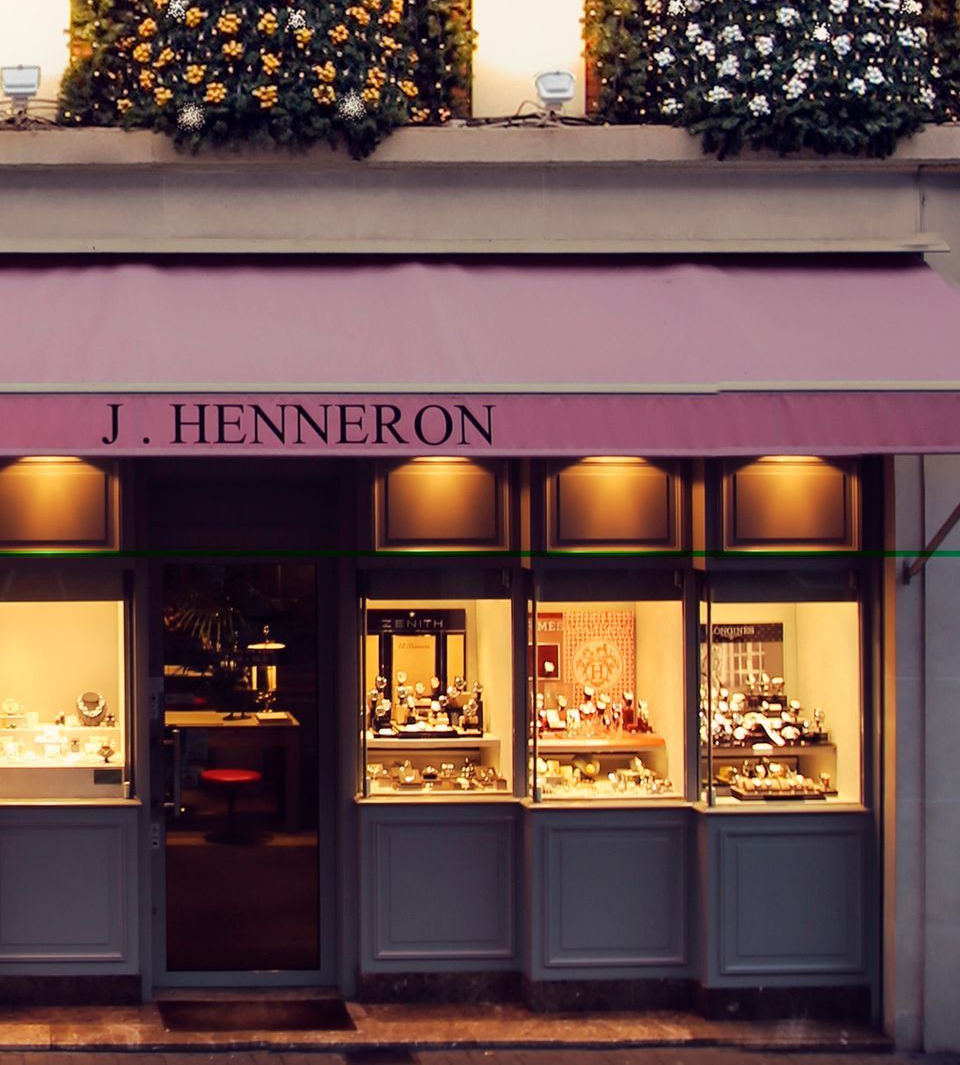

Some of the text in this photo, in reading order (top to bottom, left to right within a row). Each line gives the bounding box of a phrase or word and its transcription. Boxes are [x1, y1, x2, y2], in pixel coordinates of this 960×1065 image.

[102, 403, 497, 446] J. HENNERON
[381, 619, 444, 628] ZENITH
